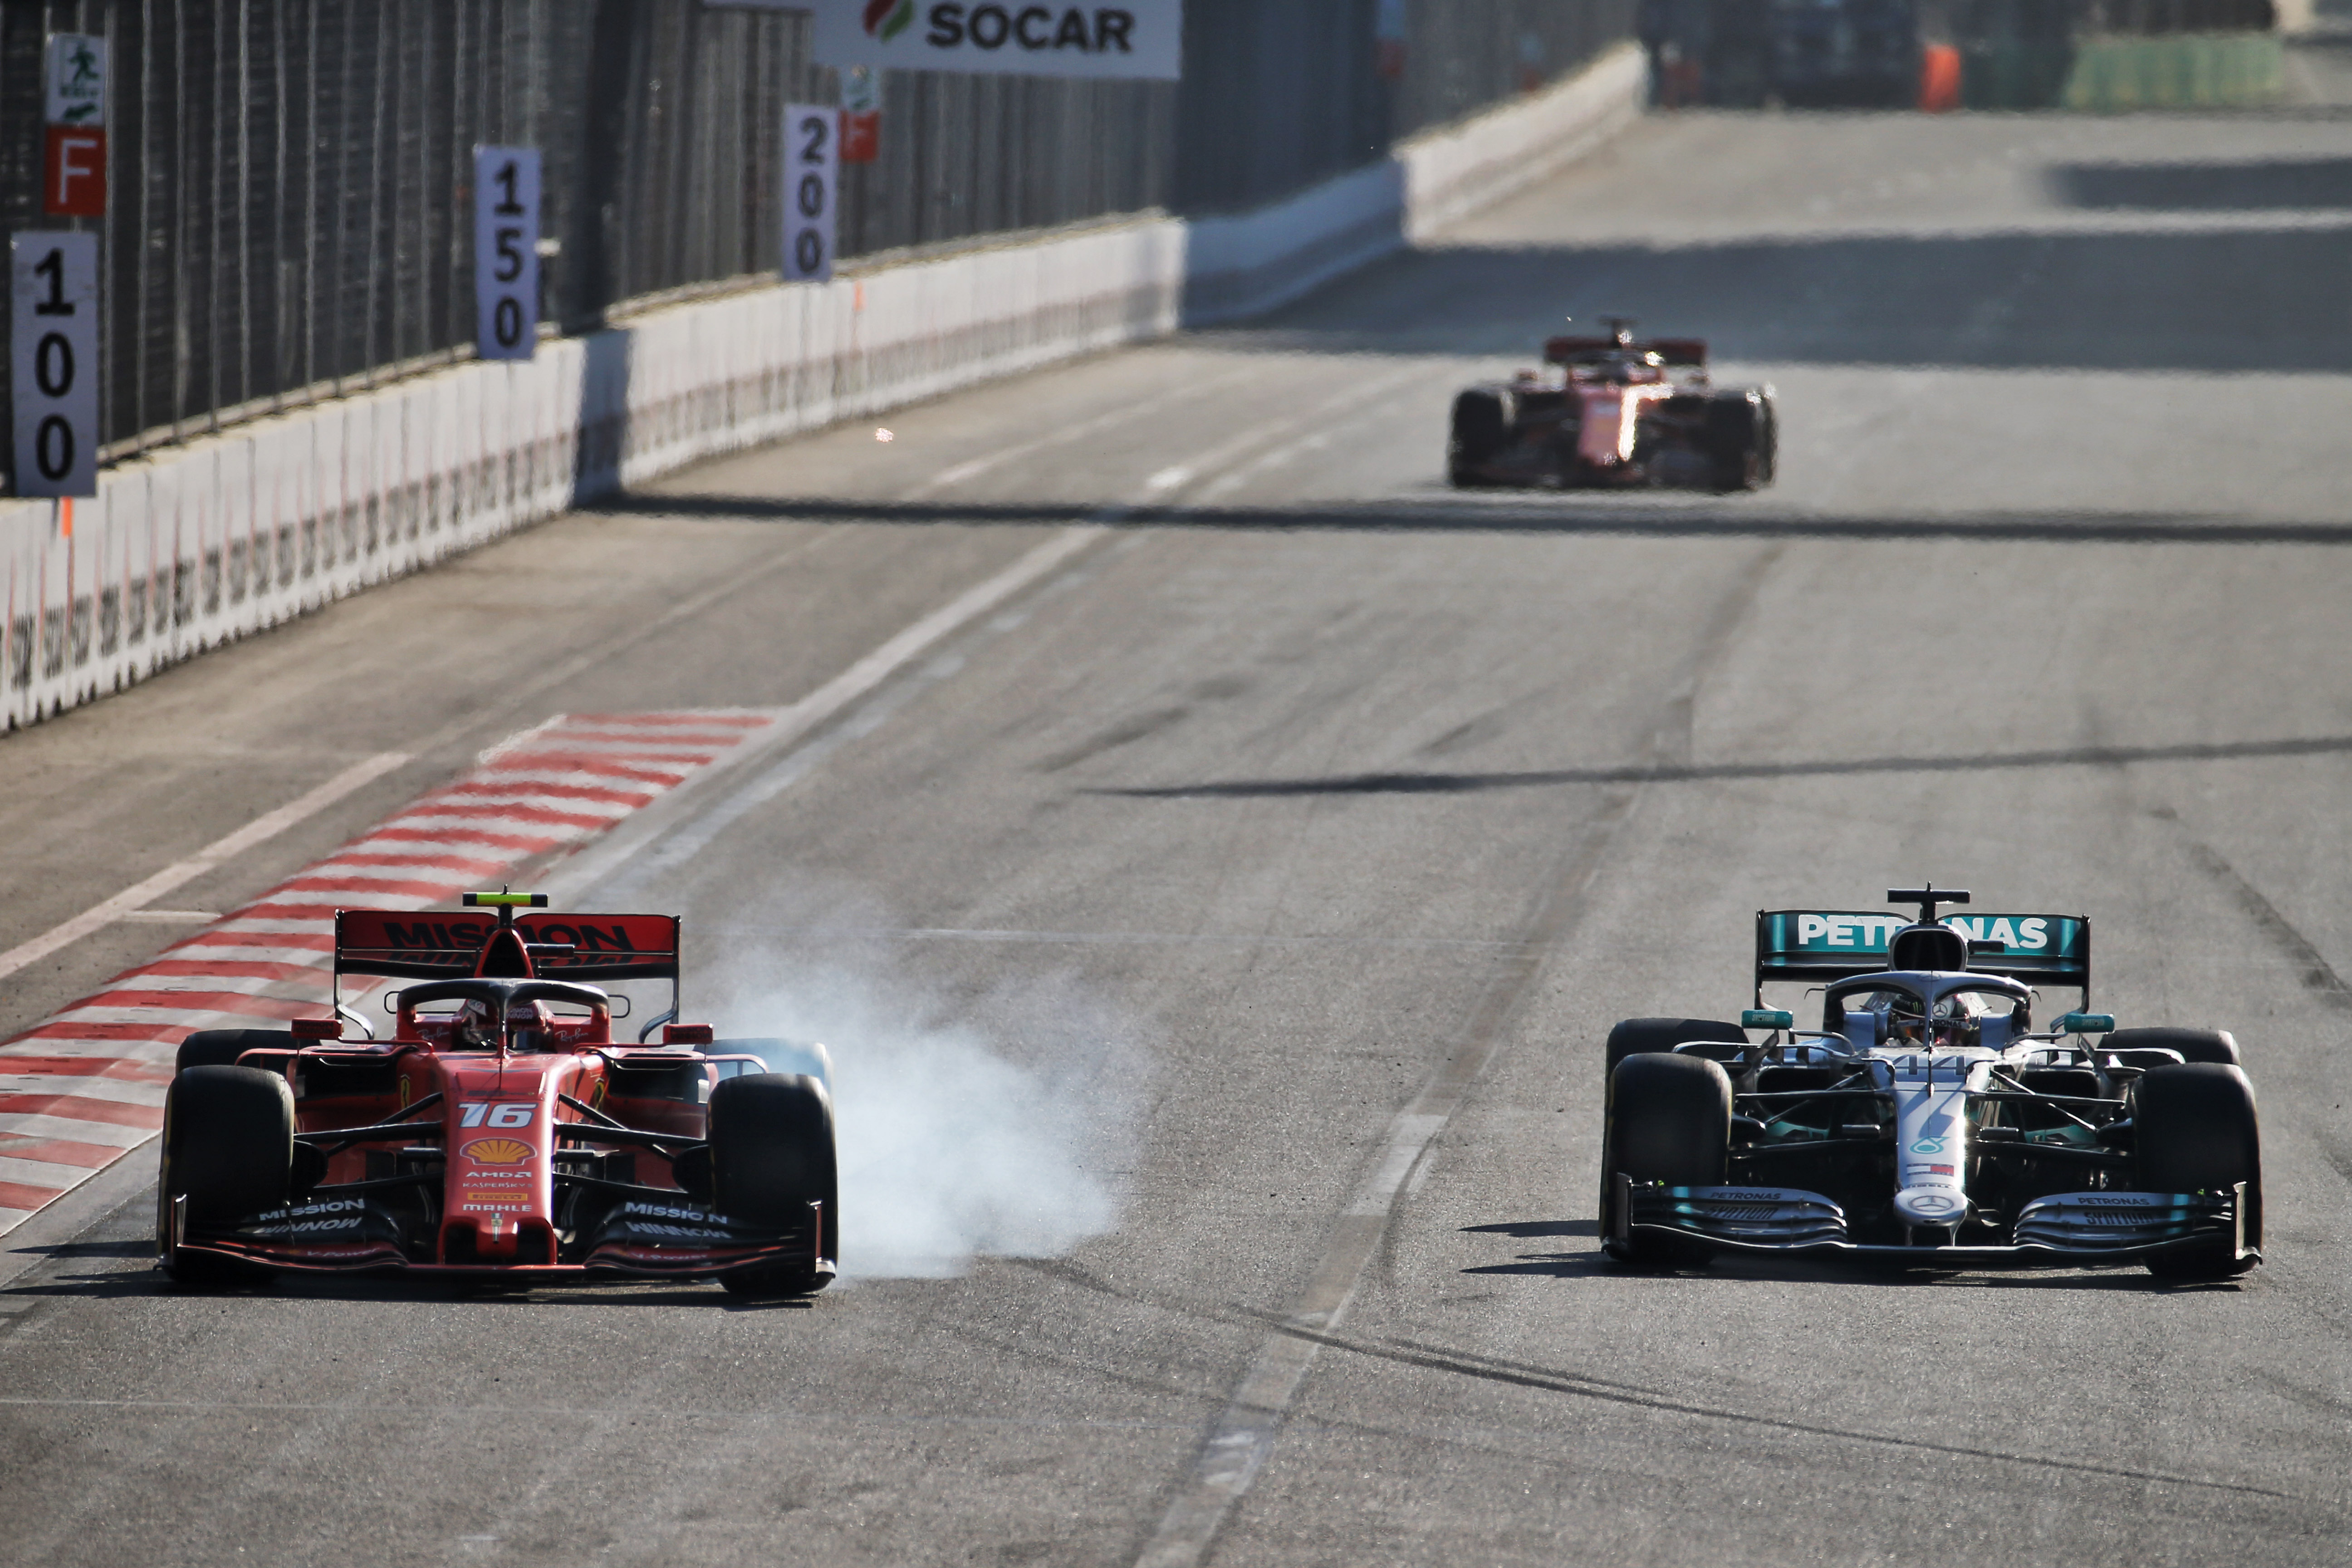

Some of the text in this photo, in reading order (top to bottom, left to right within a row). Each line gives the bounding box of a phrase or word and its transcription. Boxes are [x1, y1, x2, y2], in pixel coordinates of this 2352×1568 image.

[927, 1, 1135, 54] SOCAR
[58, 138, 98, 204] F
[795, 116, 829, 274] 200
[494, 159, 524, 348] 150
[34, 247, 75, 481] 100
[1798, 914, 2048, 949] PETNAS
[1893, 1054, 1965, 1075] 44
[458, 1102, 539, 1129] 16
[1710, 1192, 1781, 1200] PETRONAS
[2078, 1197, 2150, 1206] PETRONAS
[259, 1198, 365, 1221] MISSION
[624, 1201, 728, 1224] MISSION
[253, 1217, 363, 1234] WINNOW
[625, 1221, 732, 1239] WINNOW
[307, 1247, 381, 1257] V-Power
